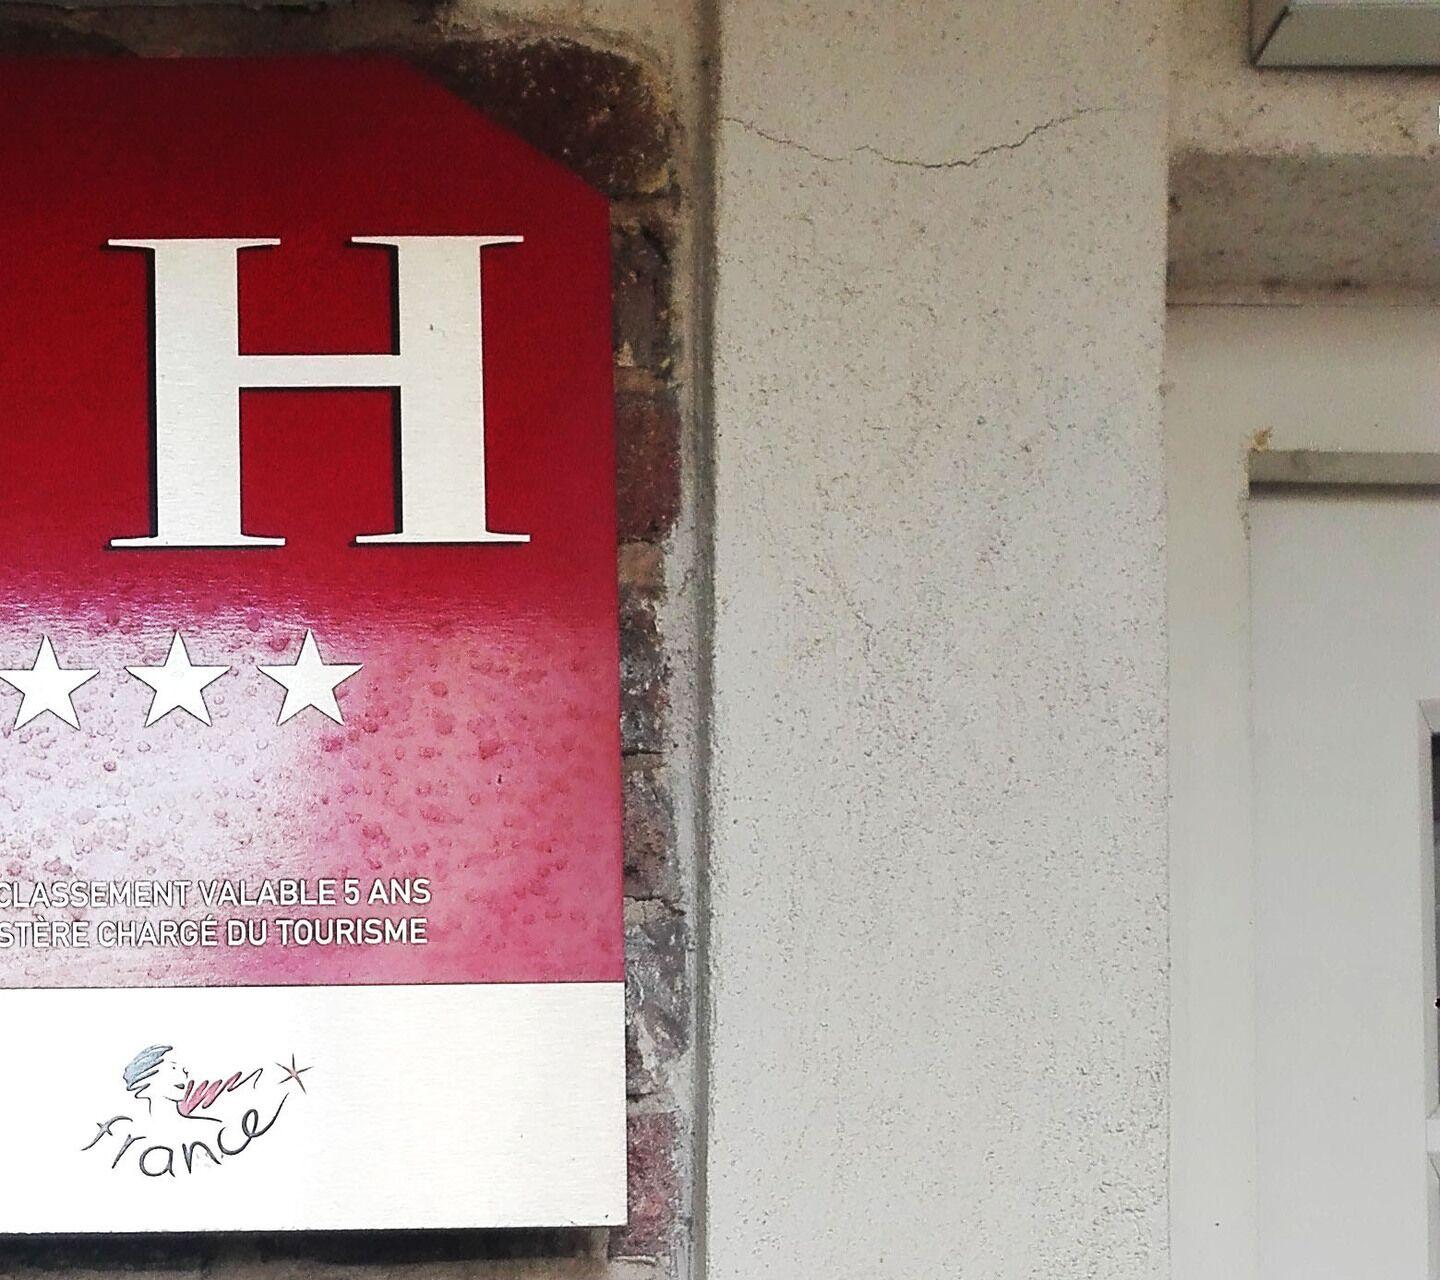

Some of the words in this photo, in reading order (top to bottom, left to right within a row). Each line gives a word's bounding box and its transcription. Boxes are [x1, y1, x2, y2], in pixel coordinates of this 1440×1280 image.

[107, 235, 530, 547] H
[198, 878, 337, 907] VALABLE
[344, 878, 360, 906] 5
[368, 877, 432, 905] ANS
[97, 915, 219, 947] CHARGÉ
[227, 918, 273, 946] DU
[276, 917, 428, 945] TOURISME
